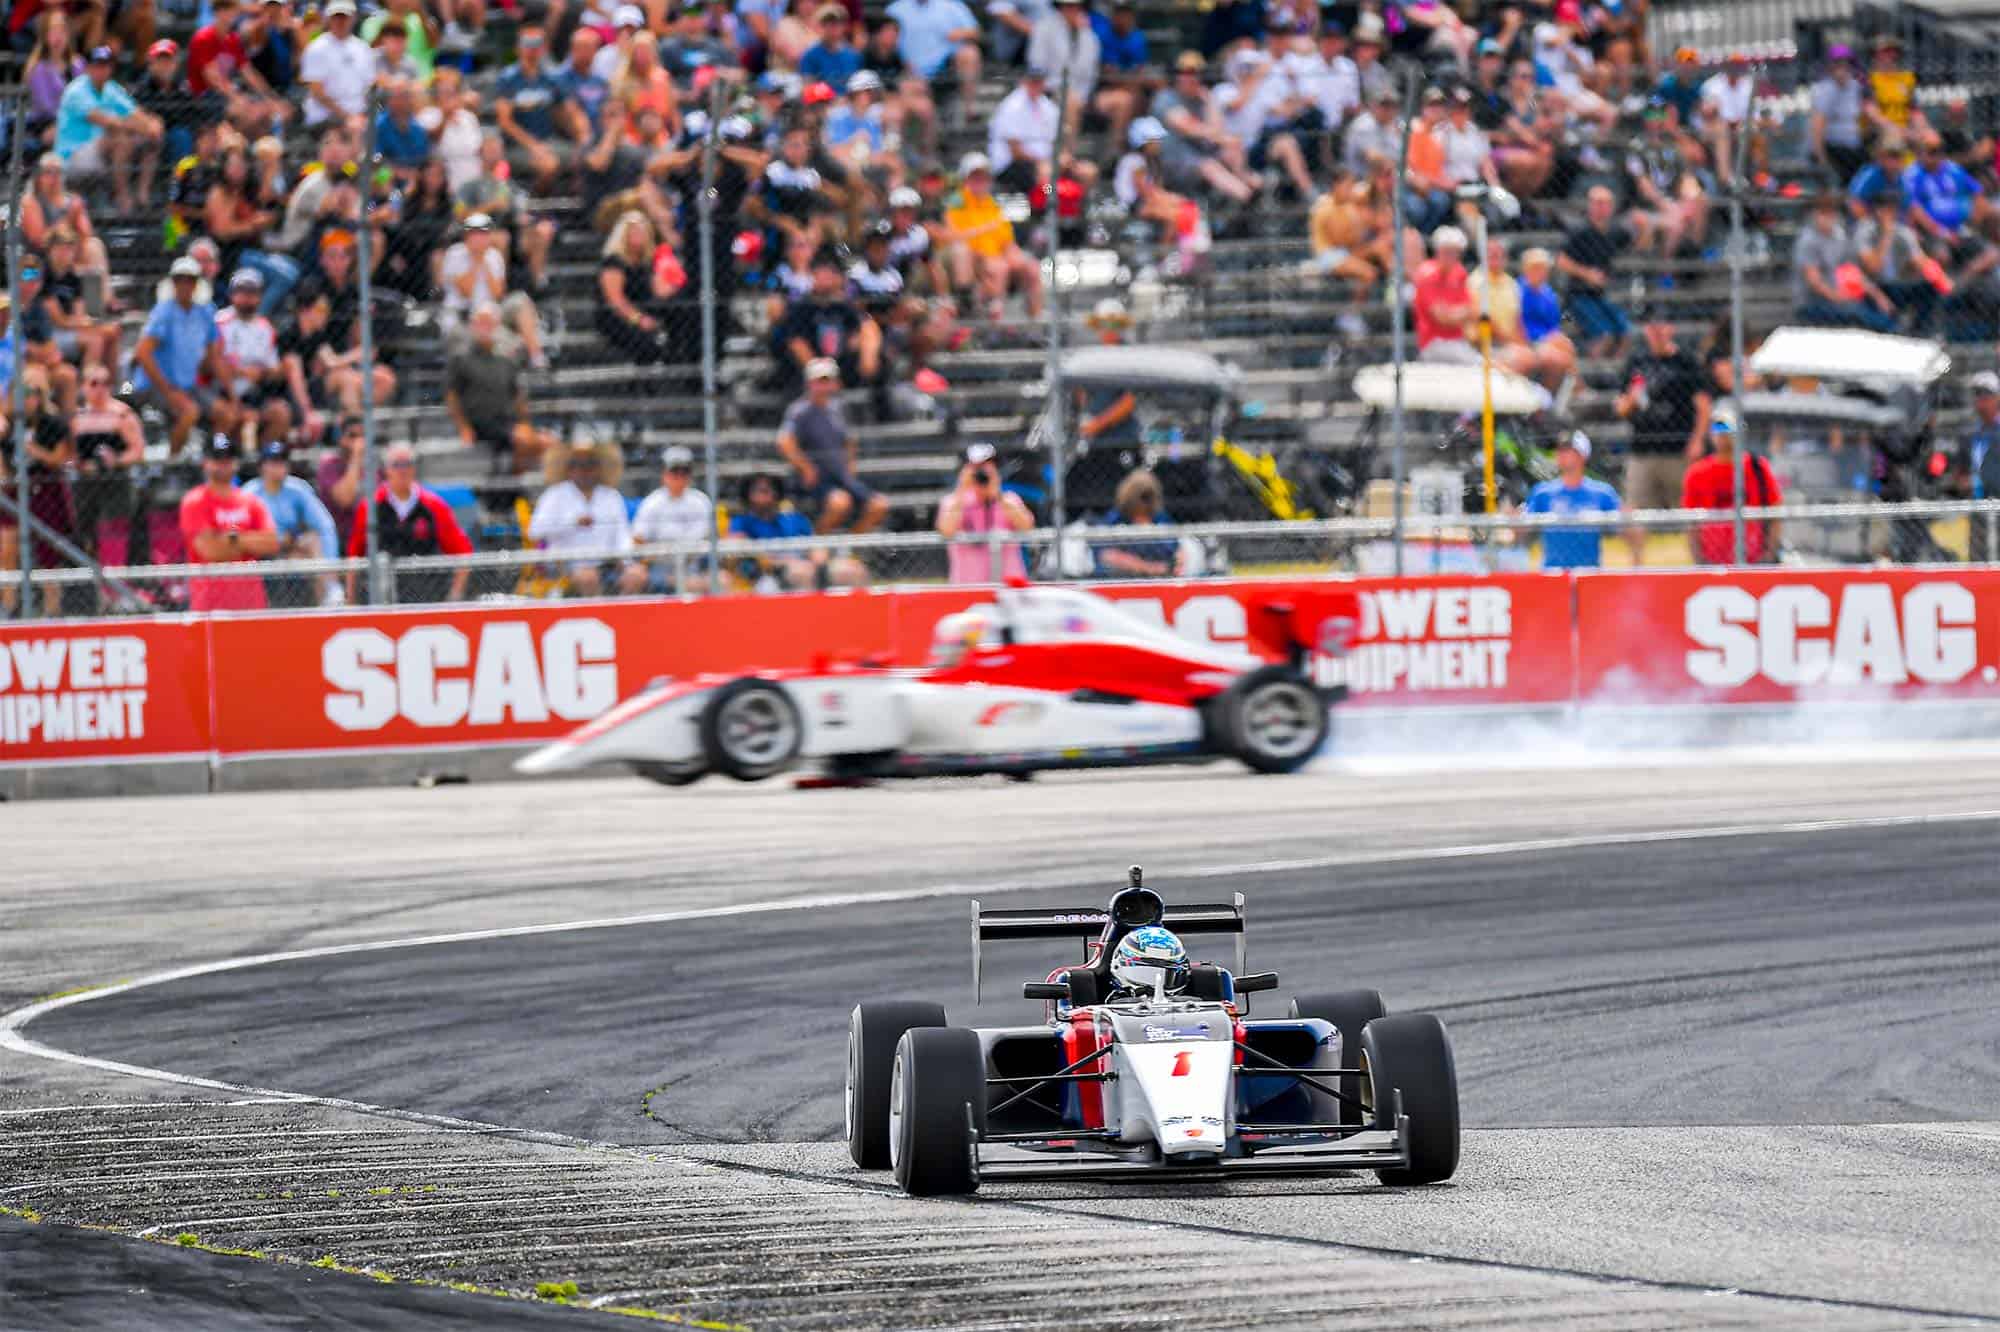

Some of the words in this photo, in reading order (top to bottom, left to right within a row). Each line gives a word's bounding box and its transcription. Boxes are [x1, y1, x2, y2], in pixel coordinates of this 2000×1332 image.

[1684, 582, 1977, 687] SCAG
[321, 618, 617, 731] SCAG
[0, 690, 148, 743] IPMENT
[1171, 1051, 1193, 1076] 1
